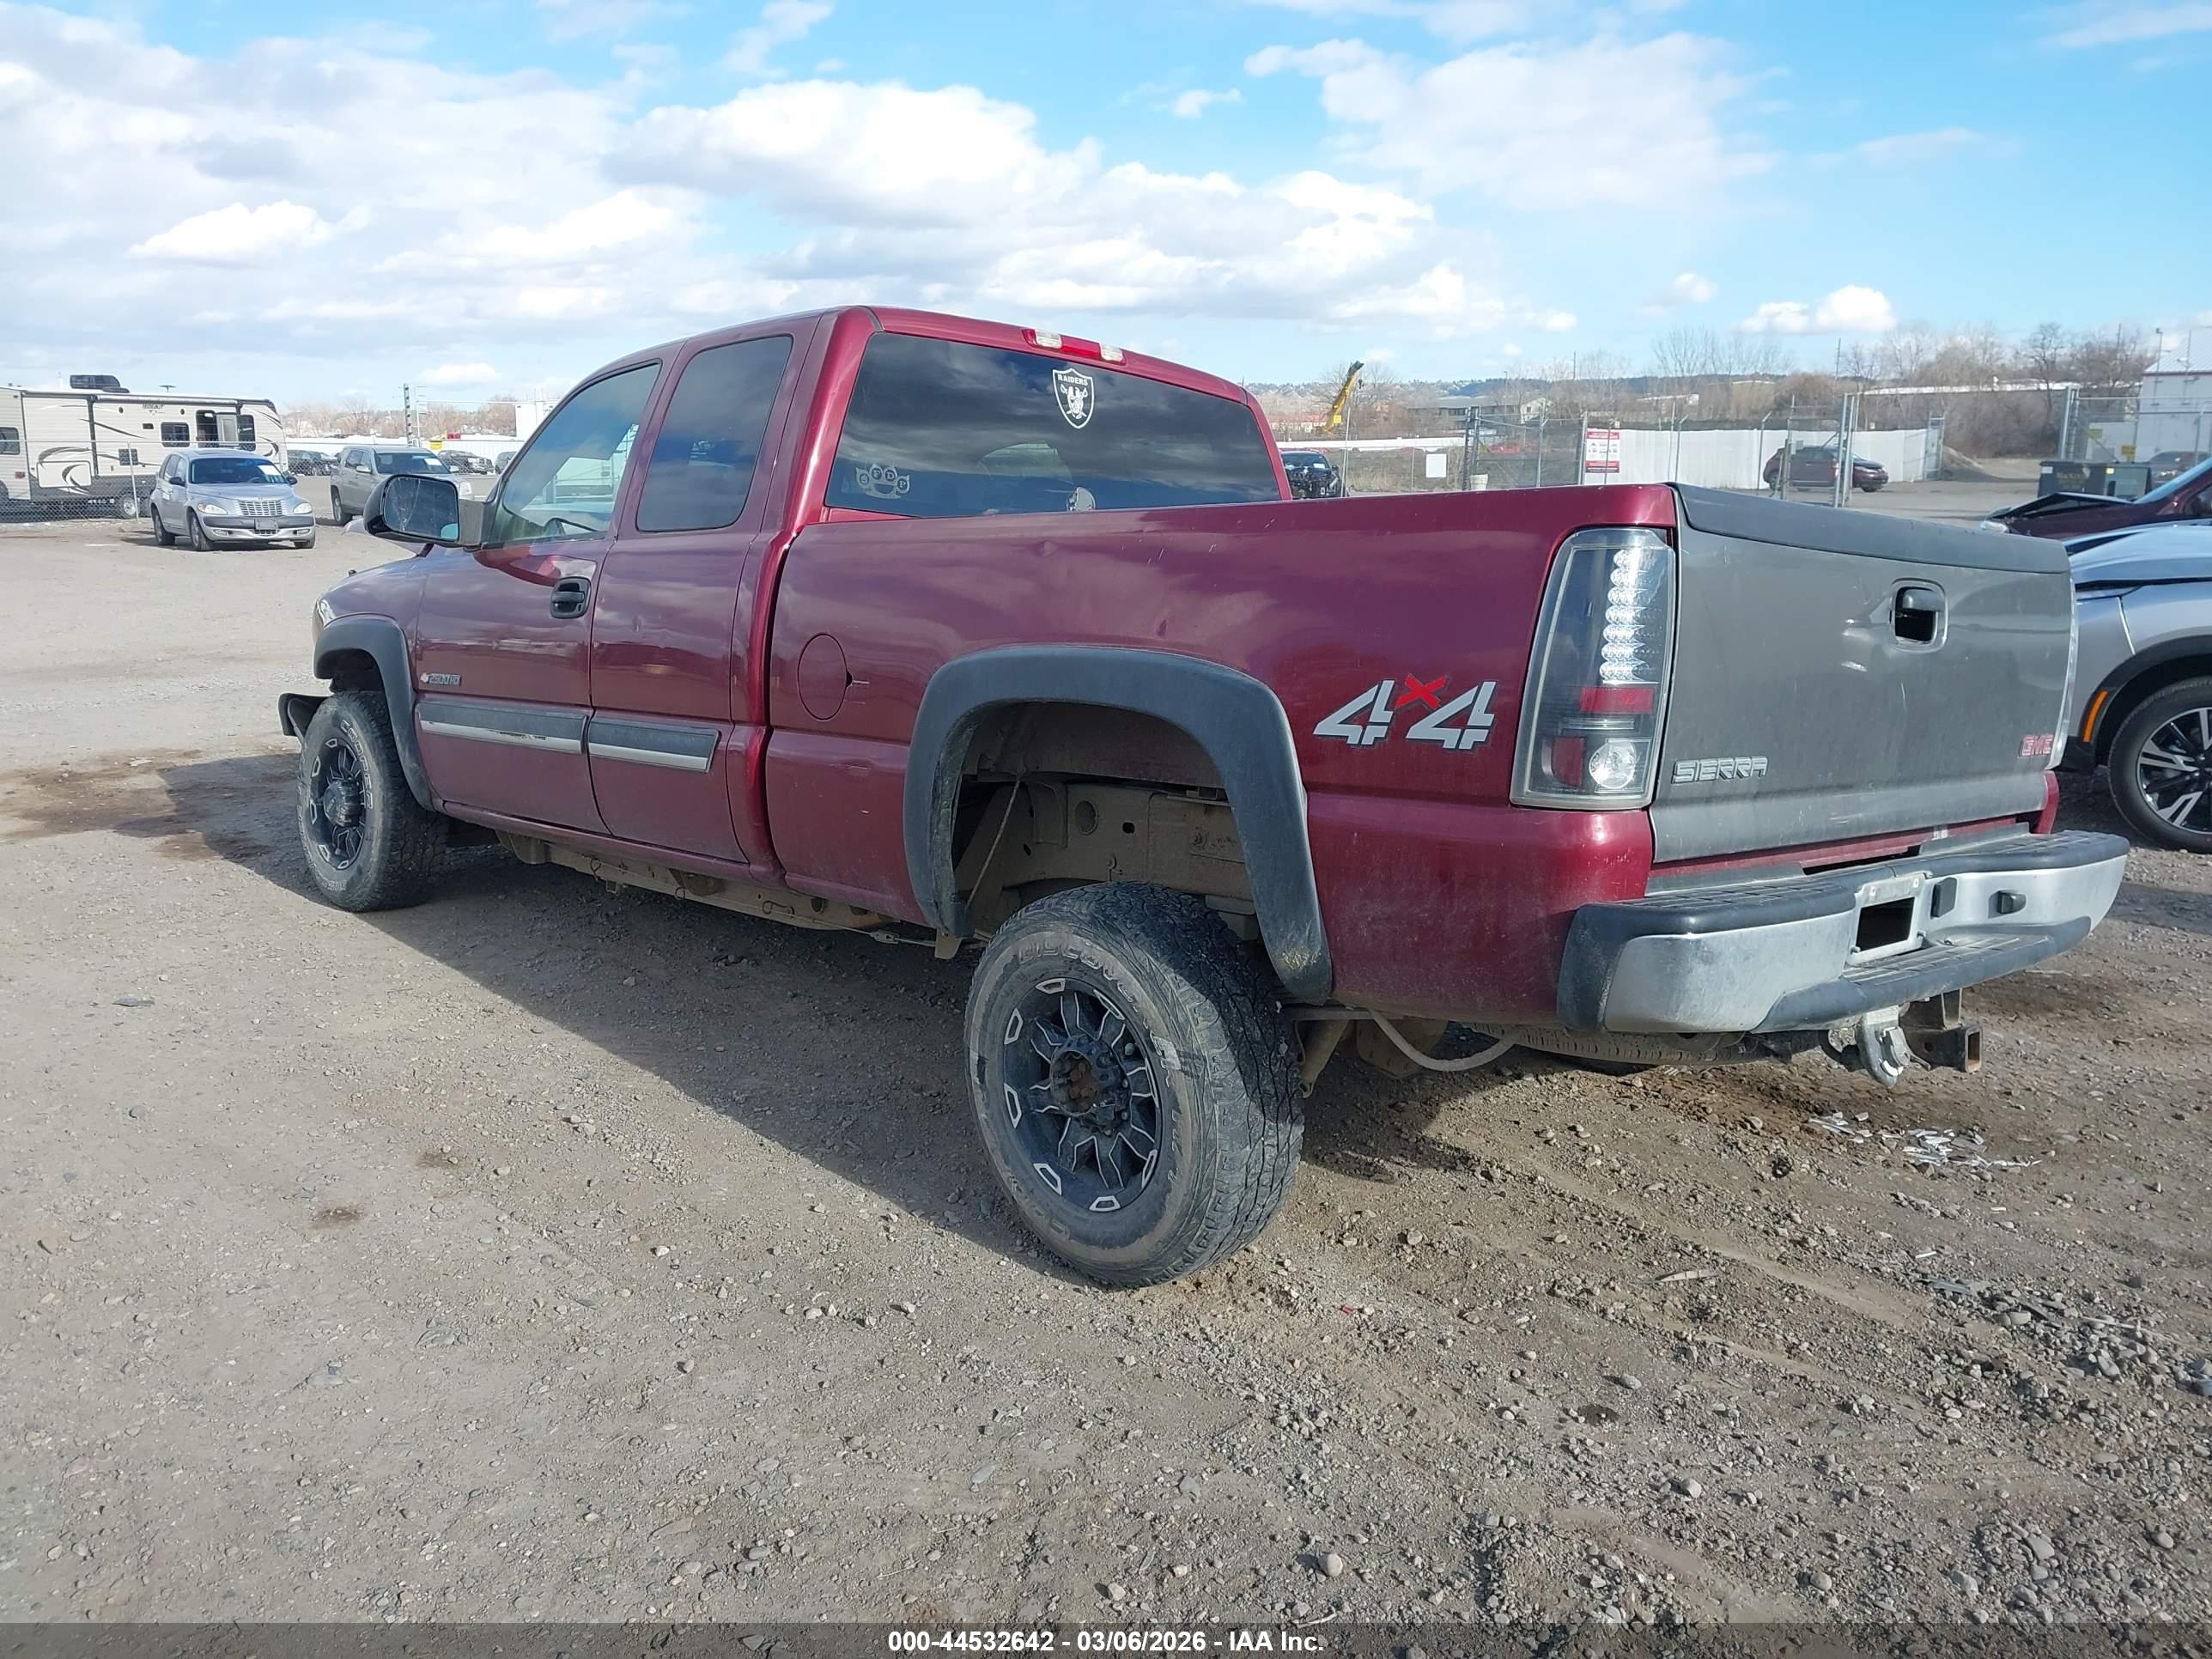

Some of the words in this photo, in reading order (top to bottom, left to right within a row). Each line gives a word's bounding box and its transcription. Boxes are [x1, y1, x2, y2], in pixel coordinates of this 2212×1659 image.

[1057, 374, 1089, 386] RAIDERS
[2019, 734, 2053, 756] GMC
[1671, 756, 1768, 784] SIERRA
